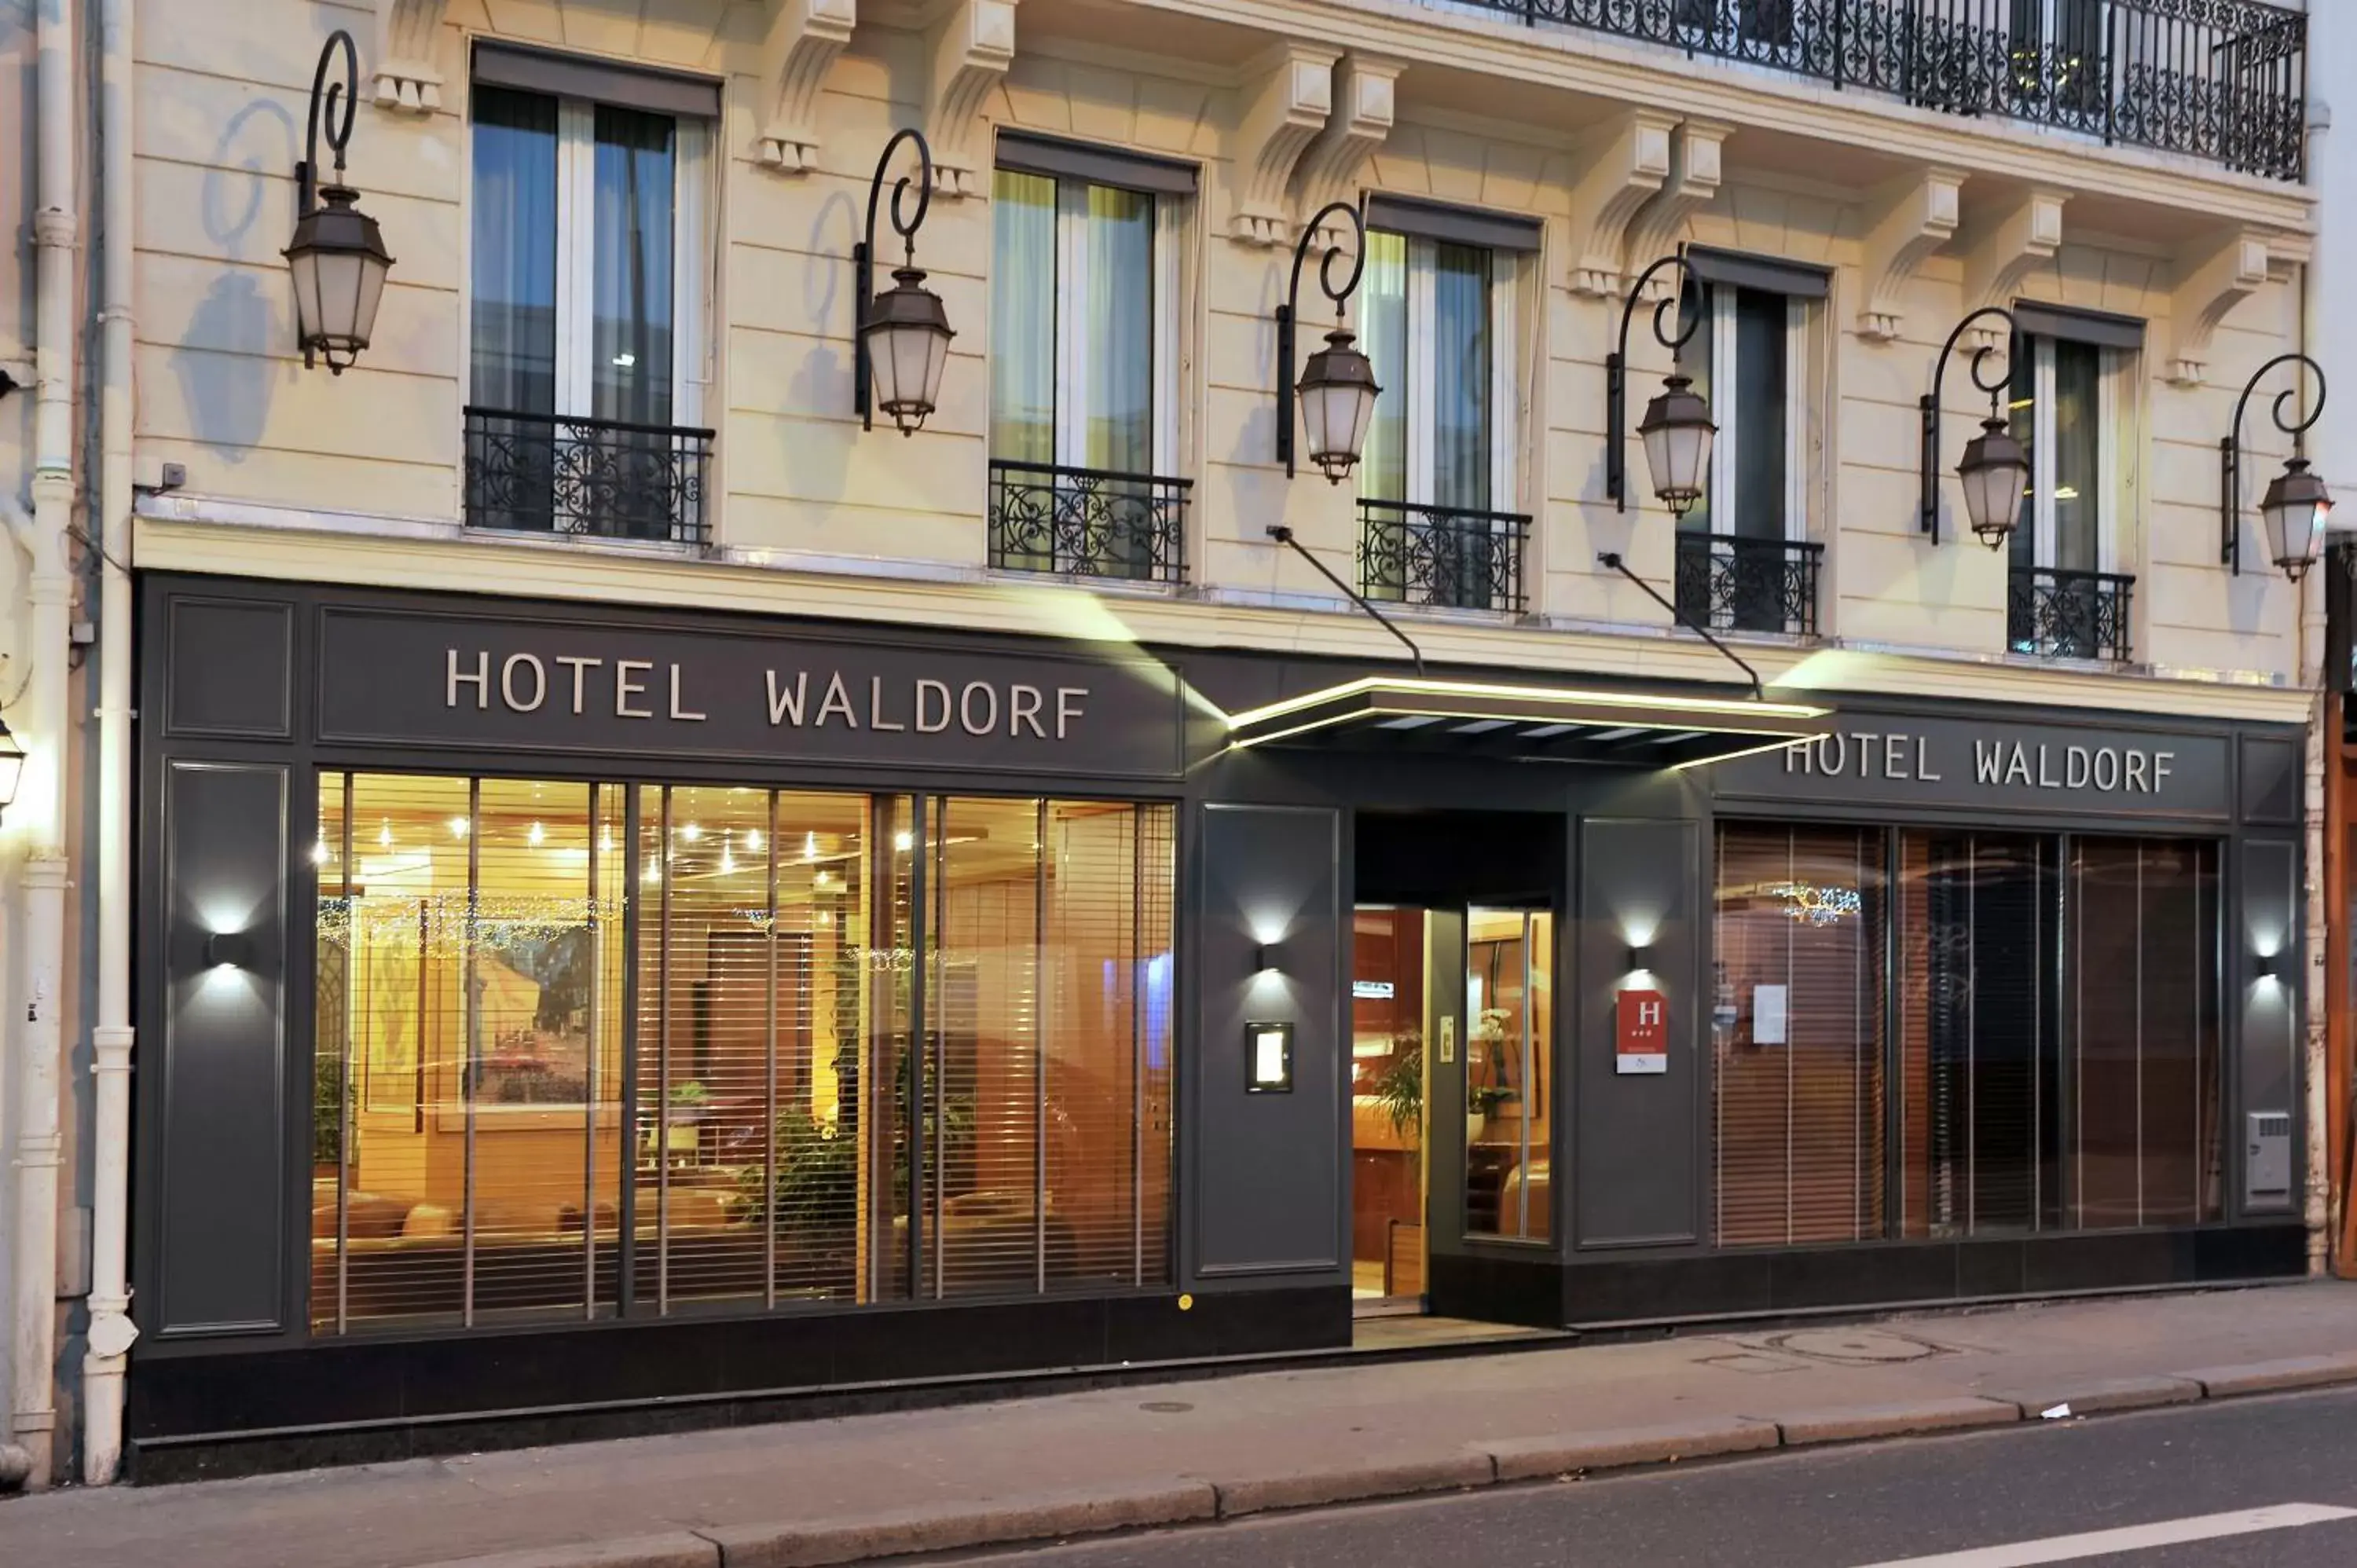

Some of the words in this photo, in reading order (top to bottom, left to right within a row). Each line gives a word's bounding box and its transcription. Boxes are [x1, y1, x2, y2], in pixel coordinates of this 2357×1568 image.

[445, 649, 707, 720] HOTEL
[765, 669, 1090, 739] WALDORF
[1786, 731, 1941, 780] HOTEL
[1976, 739, 2175, 792] WALDORF
[1640, 1002, 1659, 1025] H
